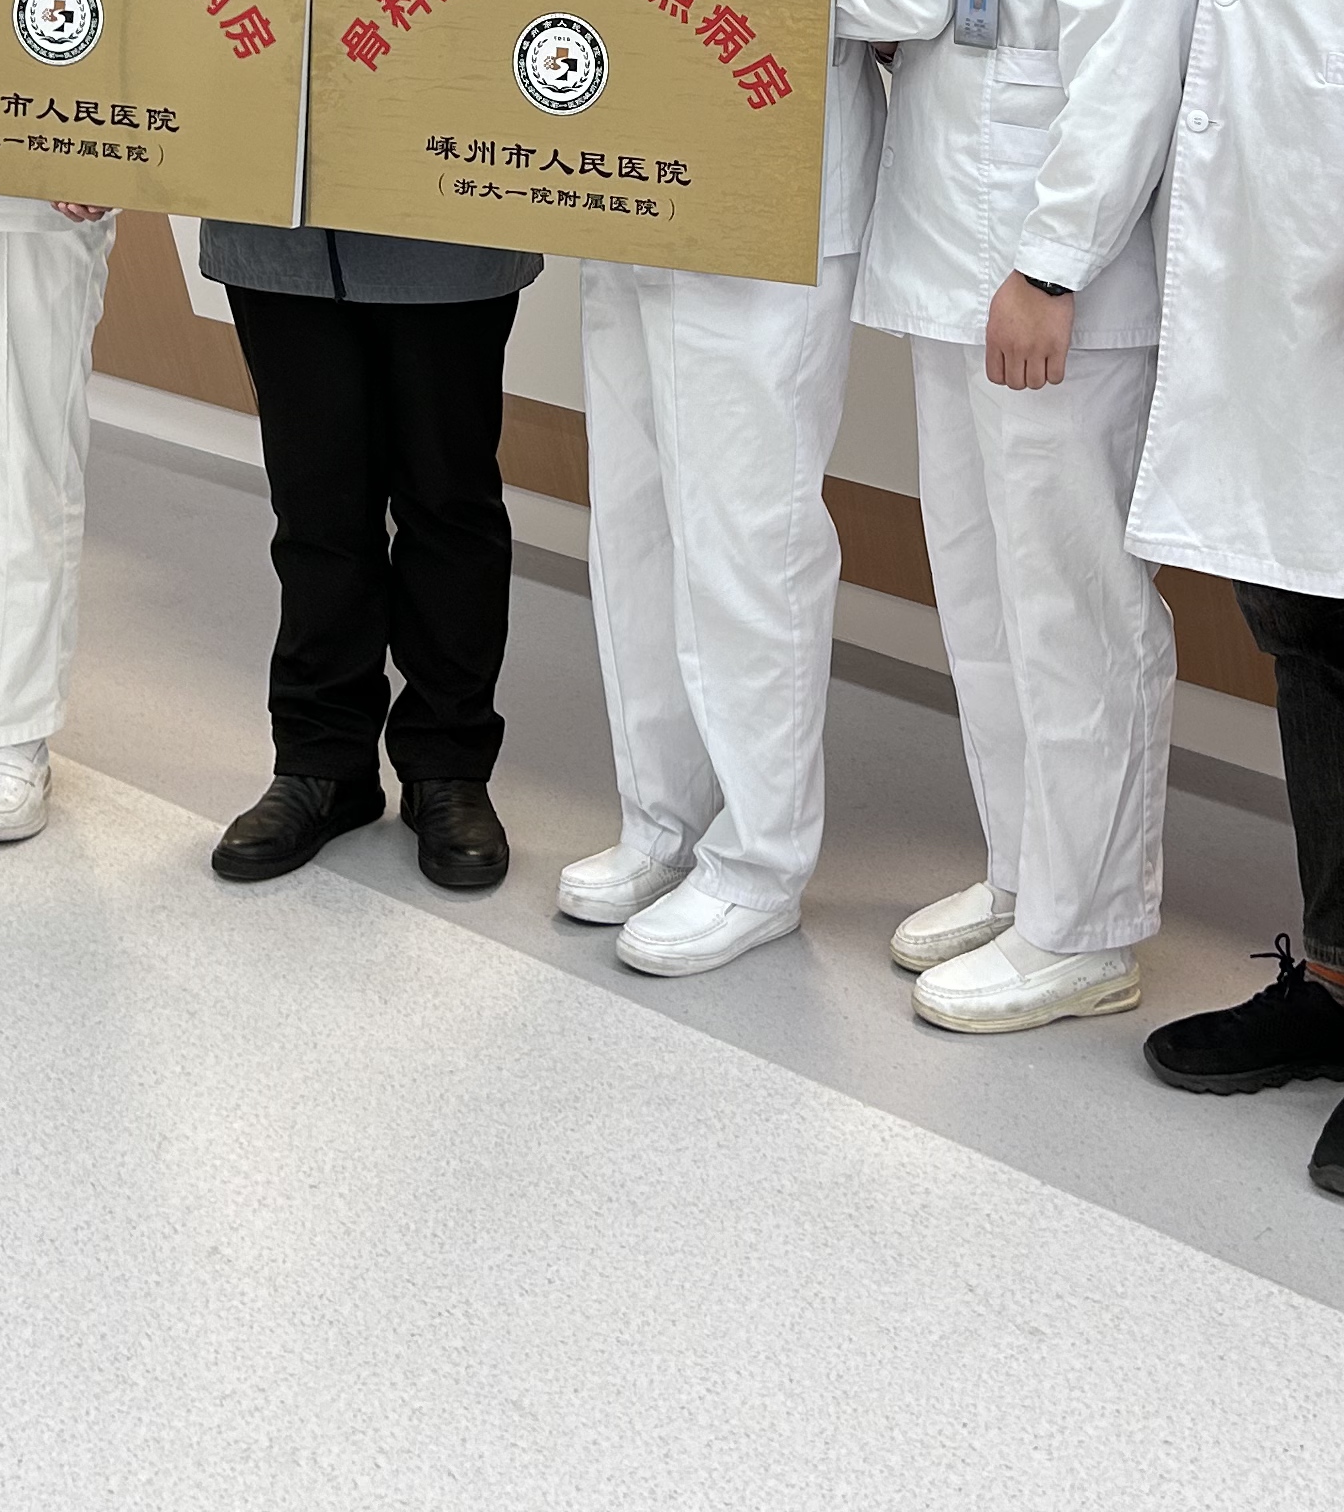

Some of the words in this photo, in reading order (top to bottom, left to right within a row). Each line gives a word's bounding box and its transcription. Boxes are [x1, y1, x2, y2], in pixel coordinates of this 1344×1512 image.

[425, 134, 693, 187] 嵊州市人民医院
